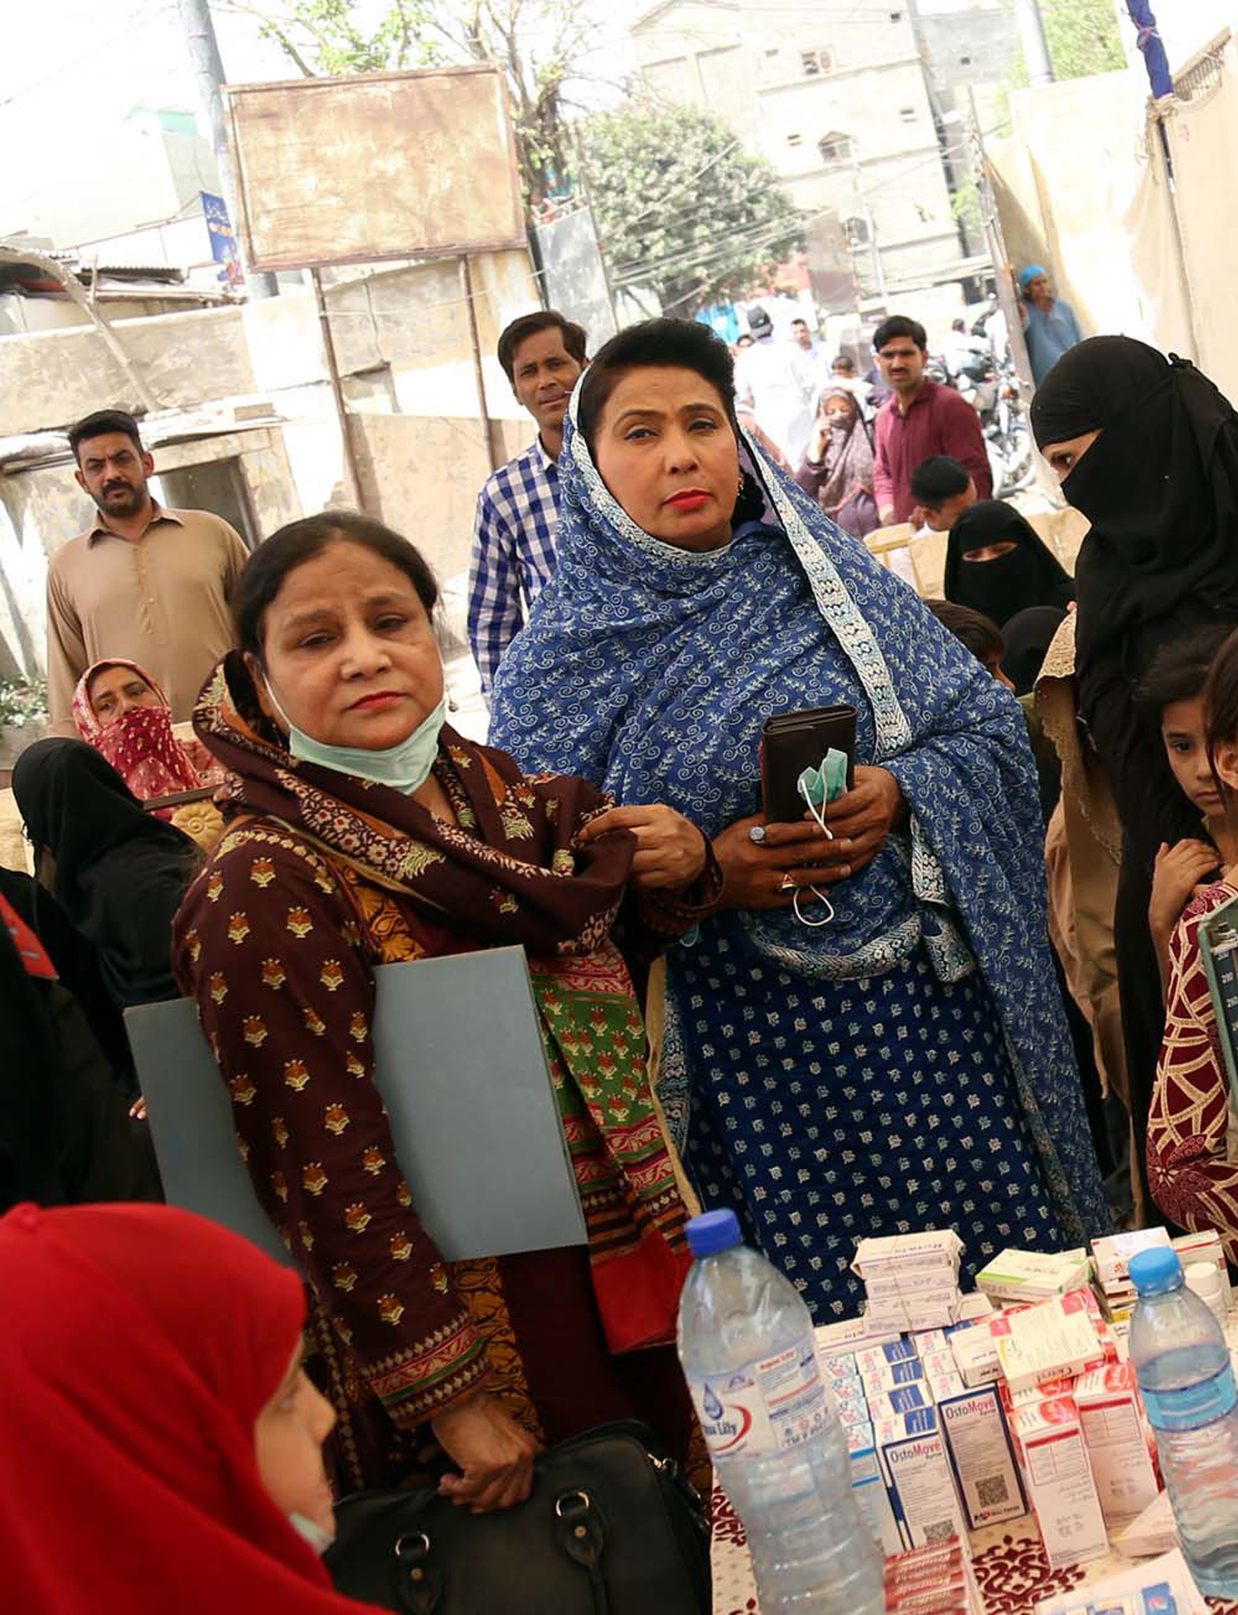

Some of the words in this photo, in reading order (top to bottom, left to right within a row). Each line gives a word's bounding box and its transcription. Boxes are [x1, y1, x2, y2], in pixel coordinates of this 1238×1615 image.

[945, 1399, 996, 1419] OstoMove
[716, 1421, 737, 1437] Lily
[889, 1440, 942, 1464] OstoMove
